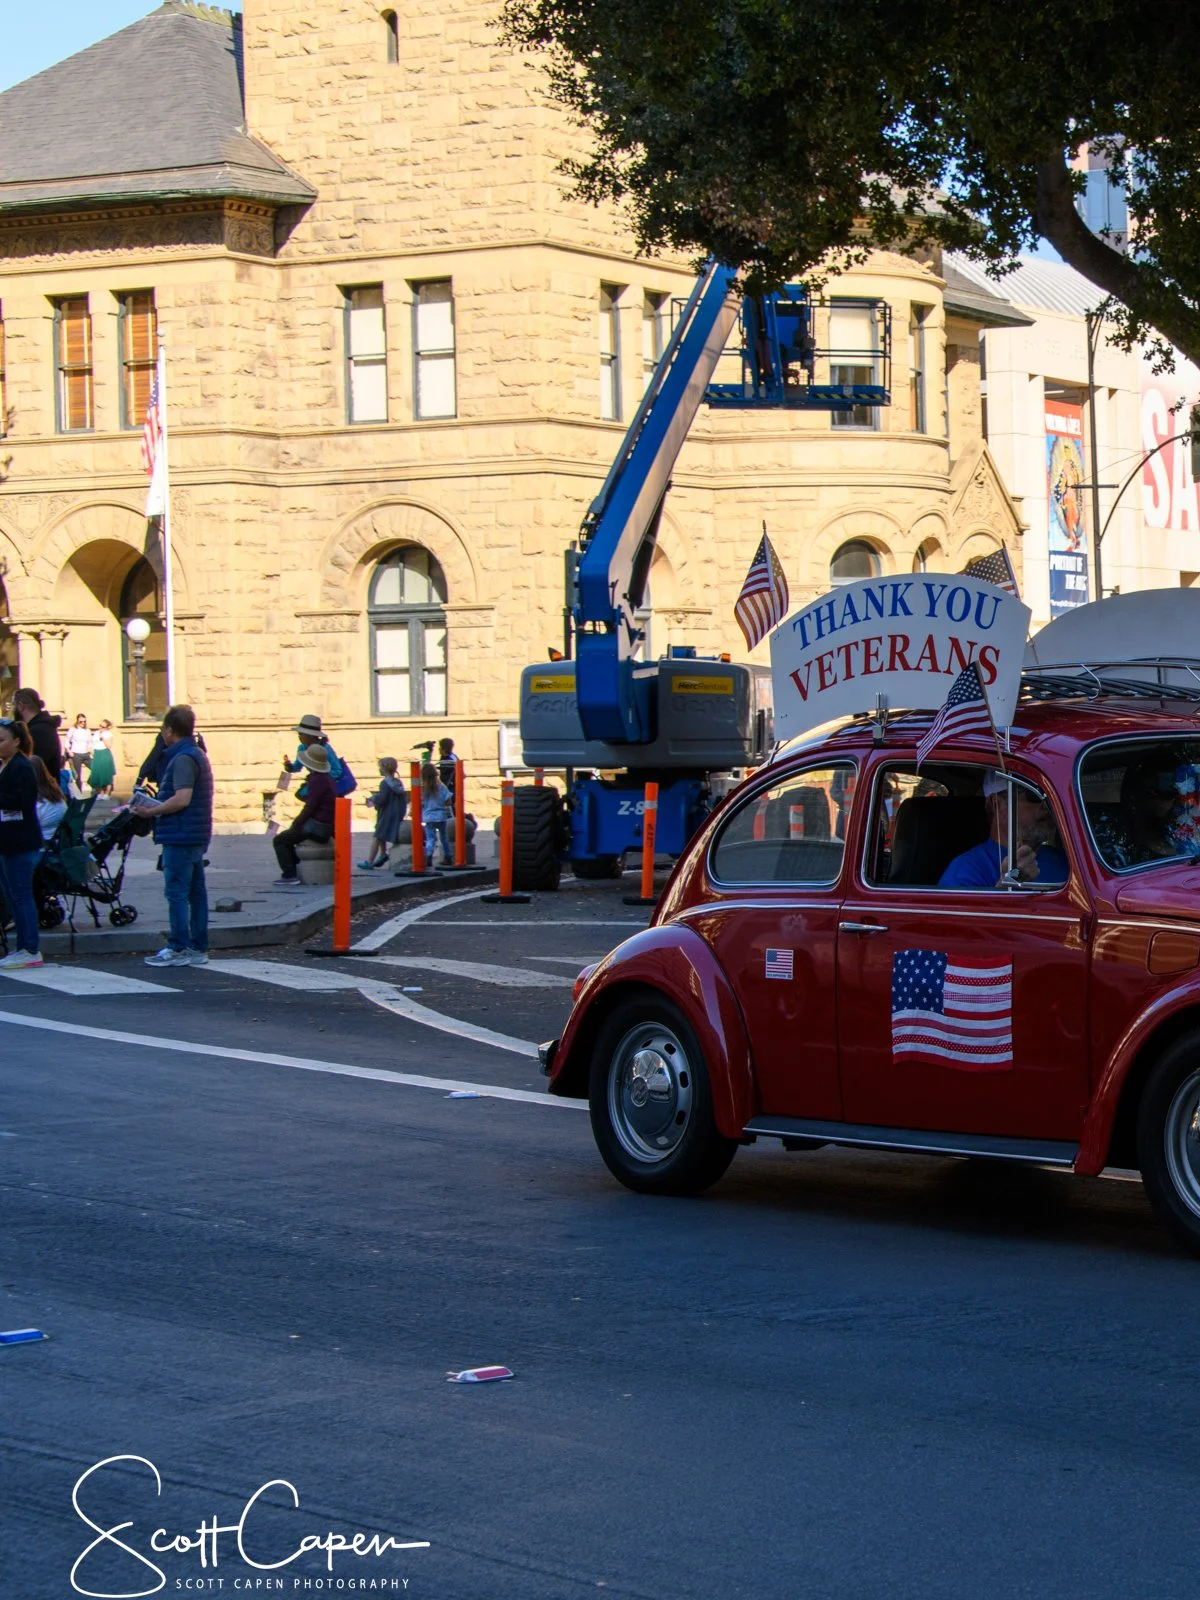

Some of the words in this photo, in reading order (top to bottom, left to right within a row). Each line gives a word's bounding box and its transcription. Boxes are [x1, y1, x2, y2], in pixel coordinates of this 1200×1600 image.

[793, 582, 914, 650] THANK
[923, 582, 1002, 630] YOU
[789, 634, 1000, 702] VETERANS
